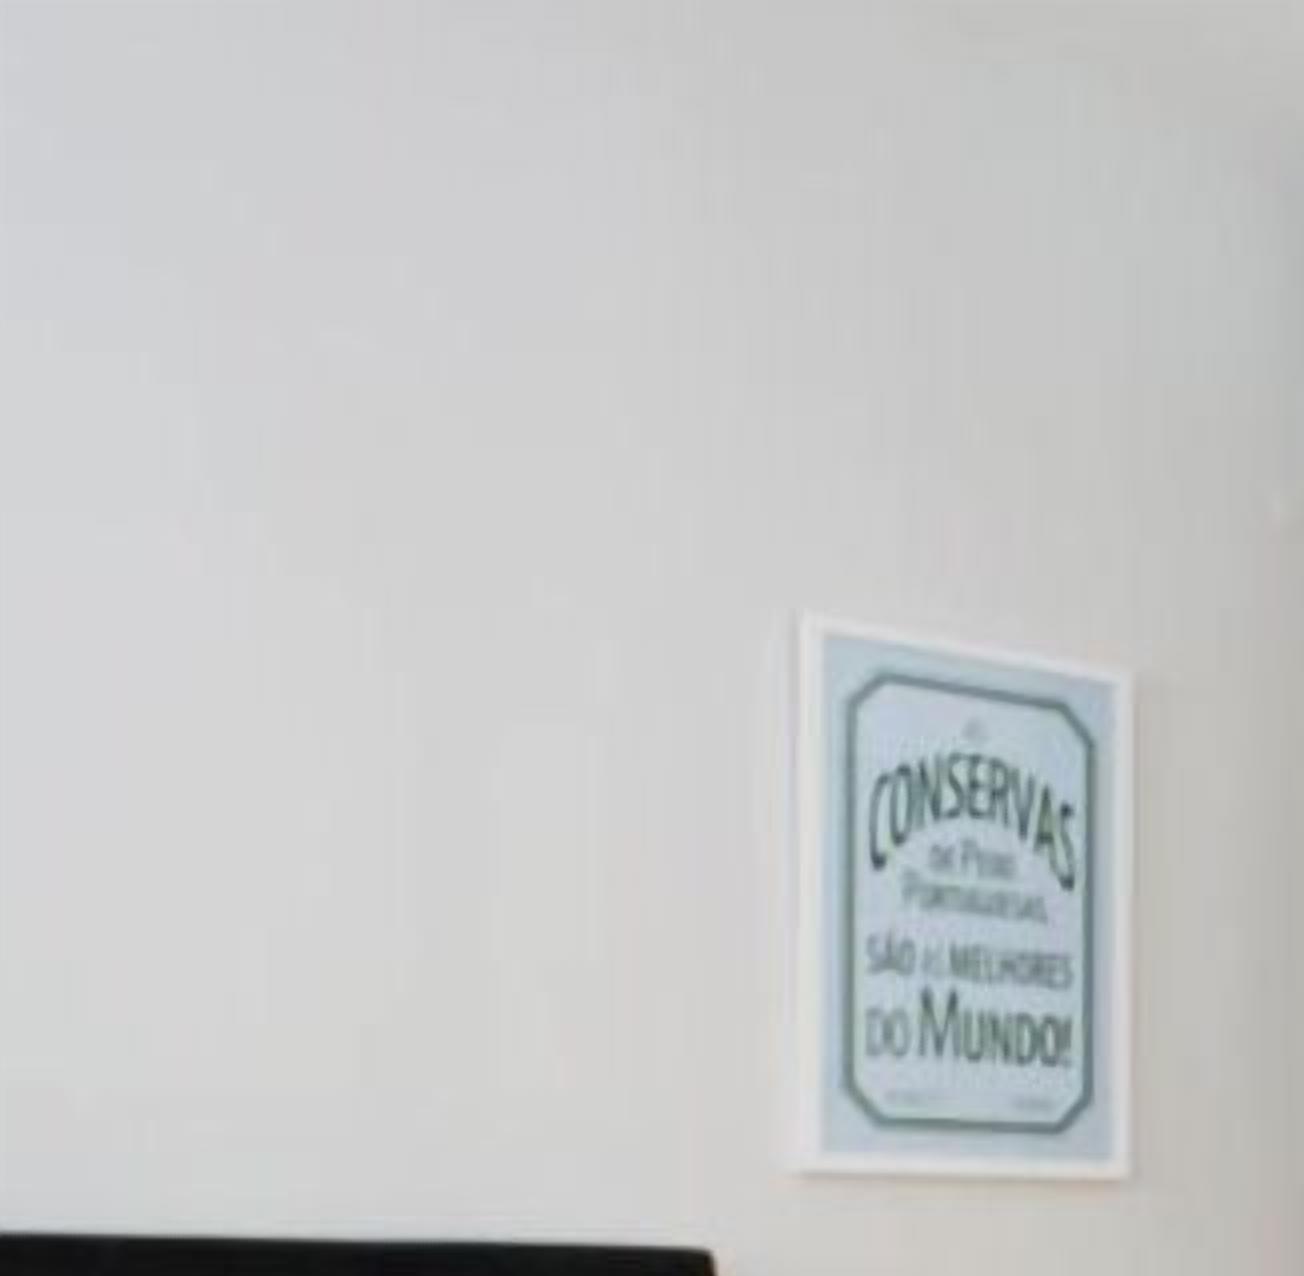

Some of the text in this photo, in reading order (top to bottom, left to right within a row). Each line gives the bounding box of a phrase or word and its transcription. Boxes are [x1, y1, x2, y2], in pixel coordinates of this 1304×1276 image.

[868, 752, 1076, 891] CONSERVAS
[866, 986, 1072, 1067] DO MUNDO!
